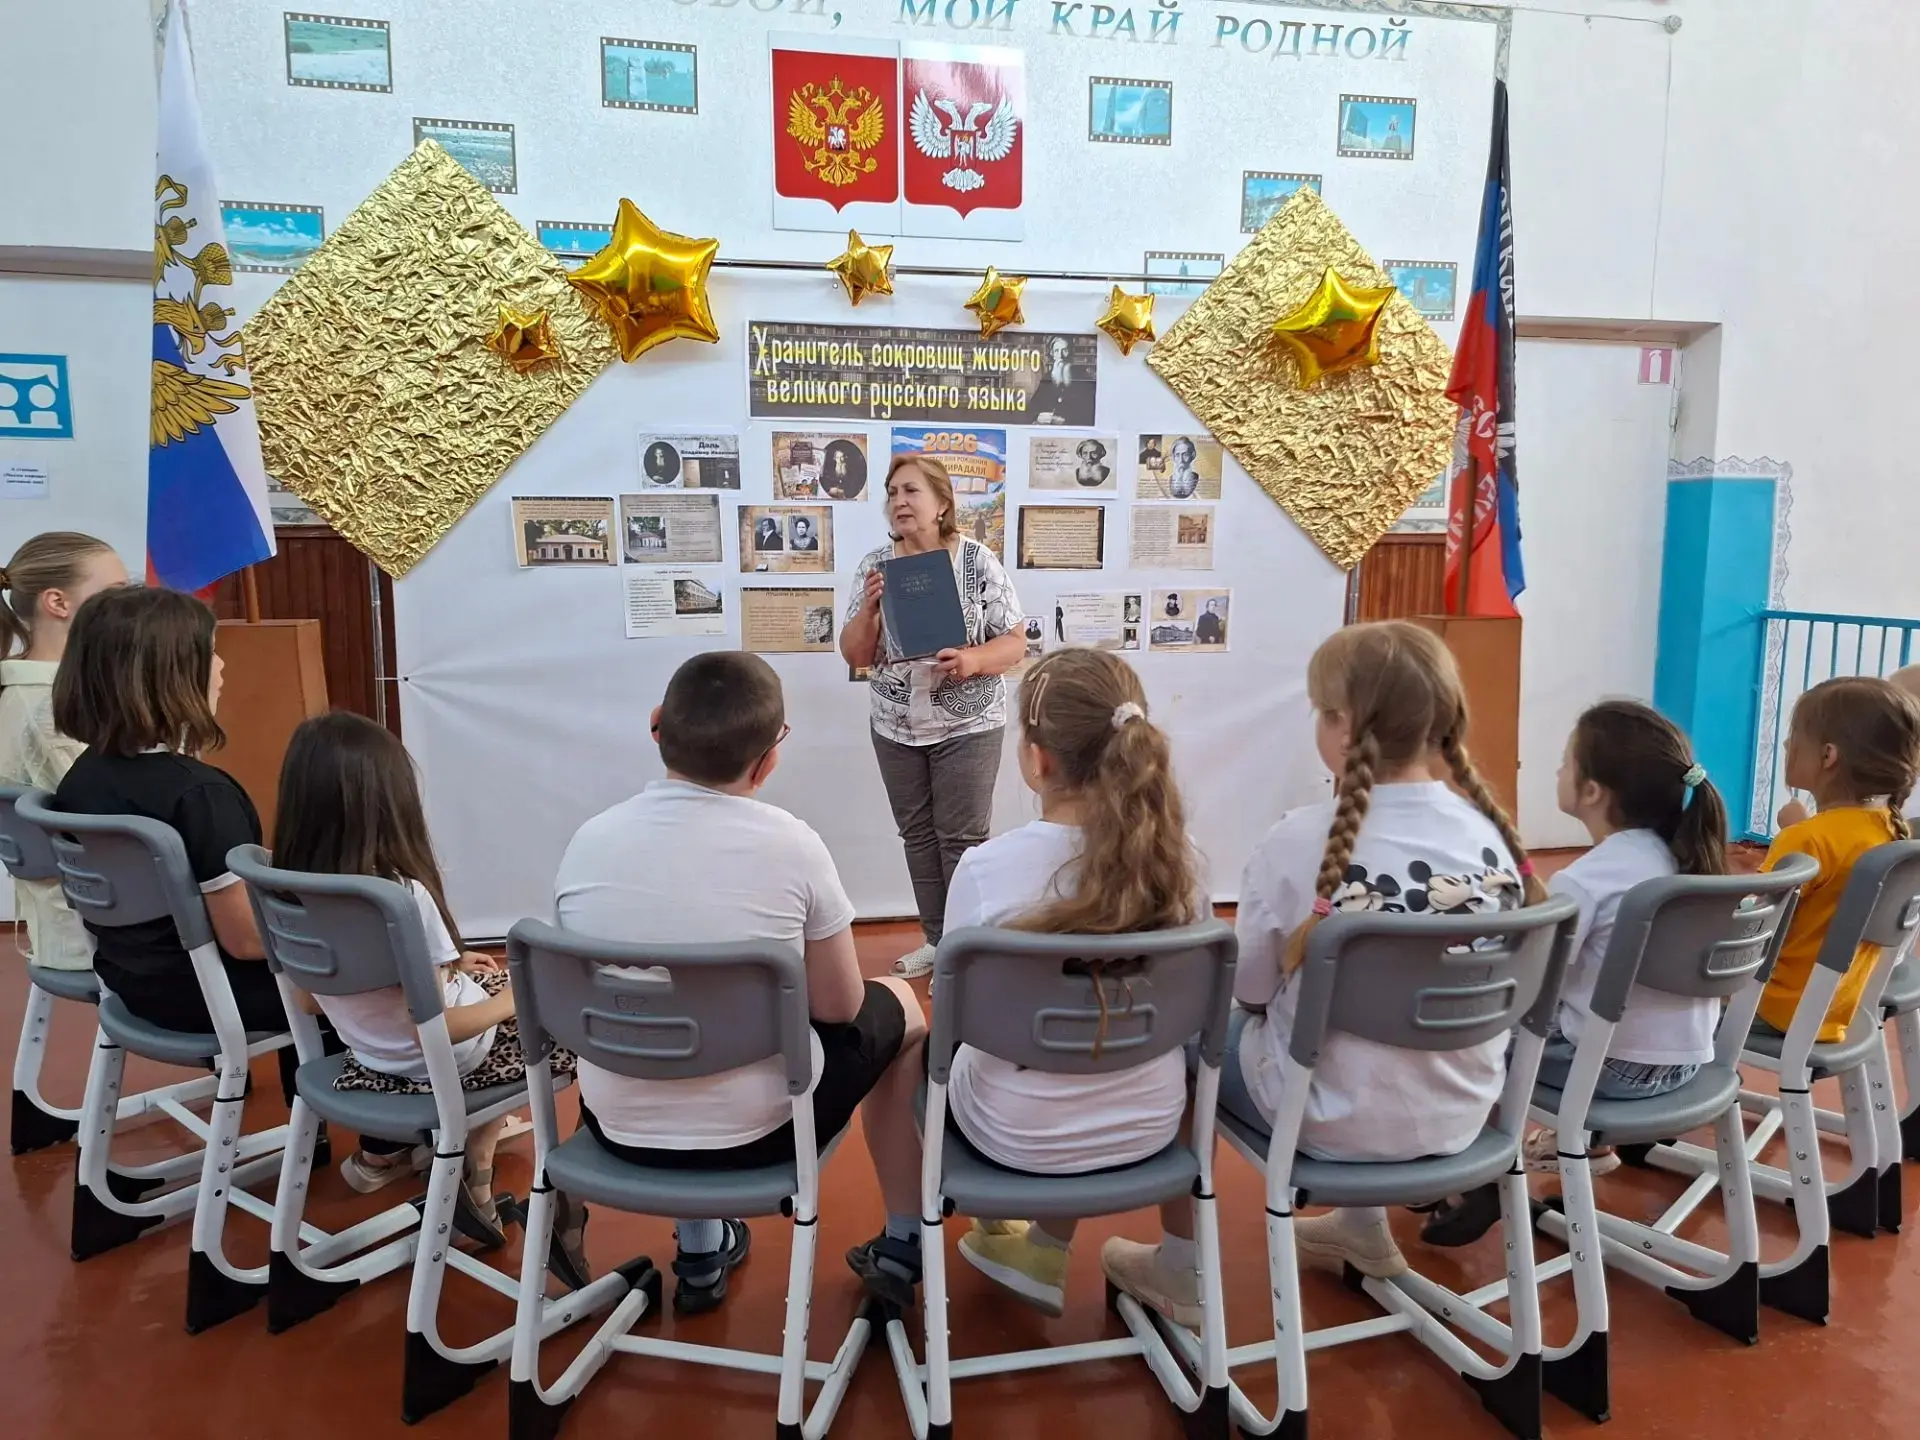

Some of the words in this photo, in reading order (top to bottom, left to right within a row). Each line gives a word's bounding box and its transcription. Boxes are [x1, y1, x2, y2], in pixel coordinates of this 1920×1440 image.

[1048, 0, 1183, 45] КРАЙ
[1210, 15, 1413, 62] РОДНОЙ
[751, 326, 864, 376] Хранитель
[871, 343, 964, 379] сокровищ
[972, 346, 1041, 372] живого
[767, 379, 862, 405] великого
[870, 382, 959, 419] русского
[967, 386, 1027, 411] языка
[923, 432, 977, 452] 2026
